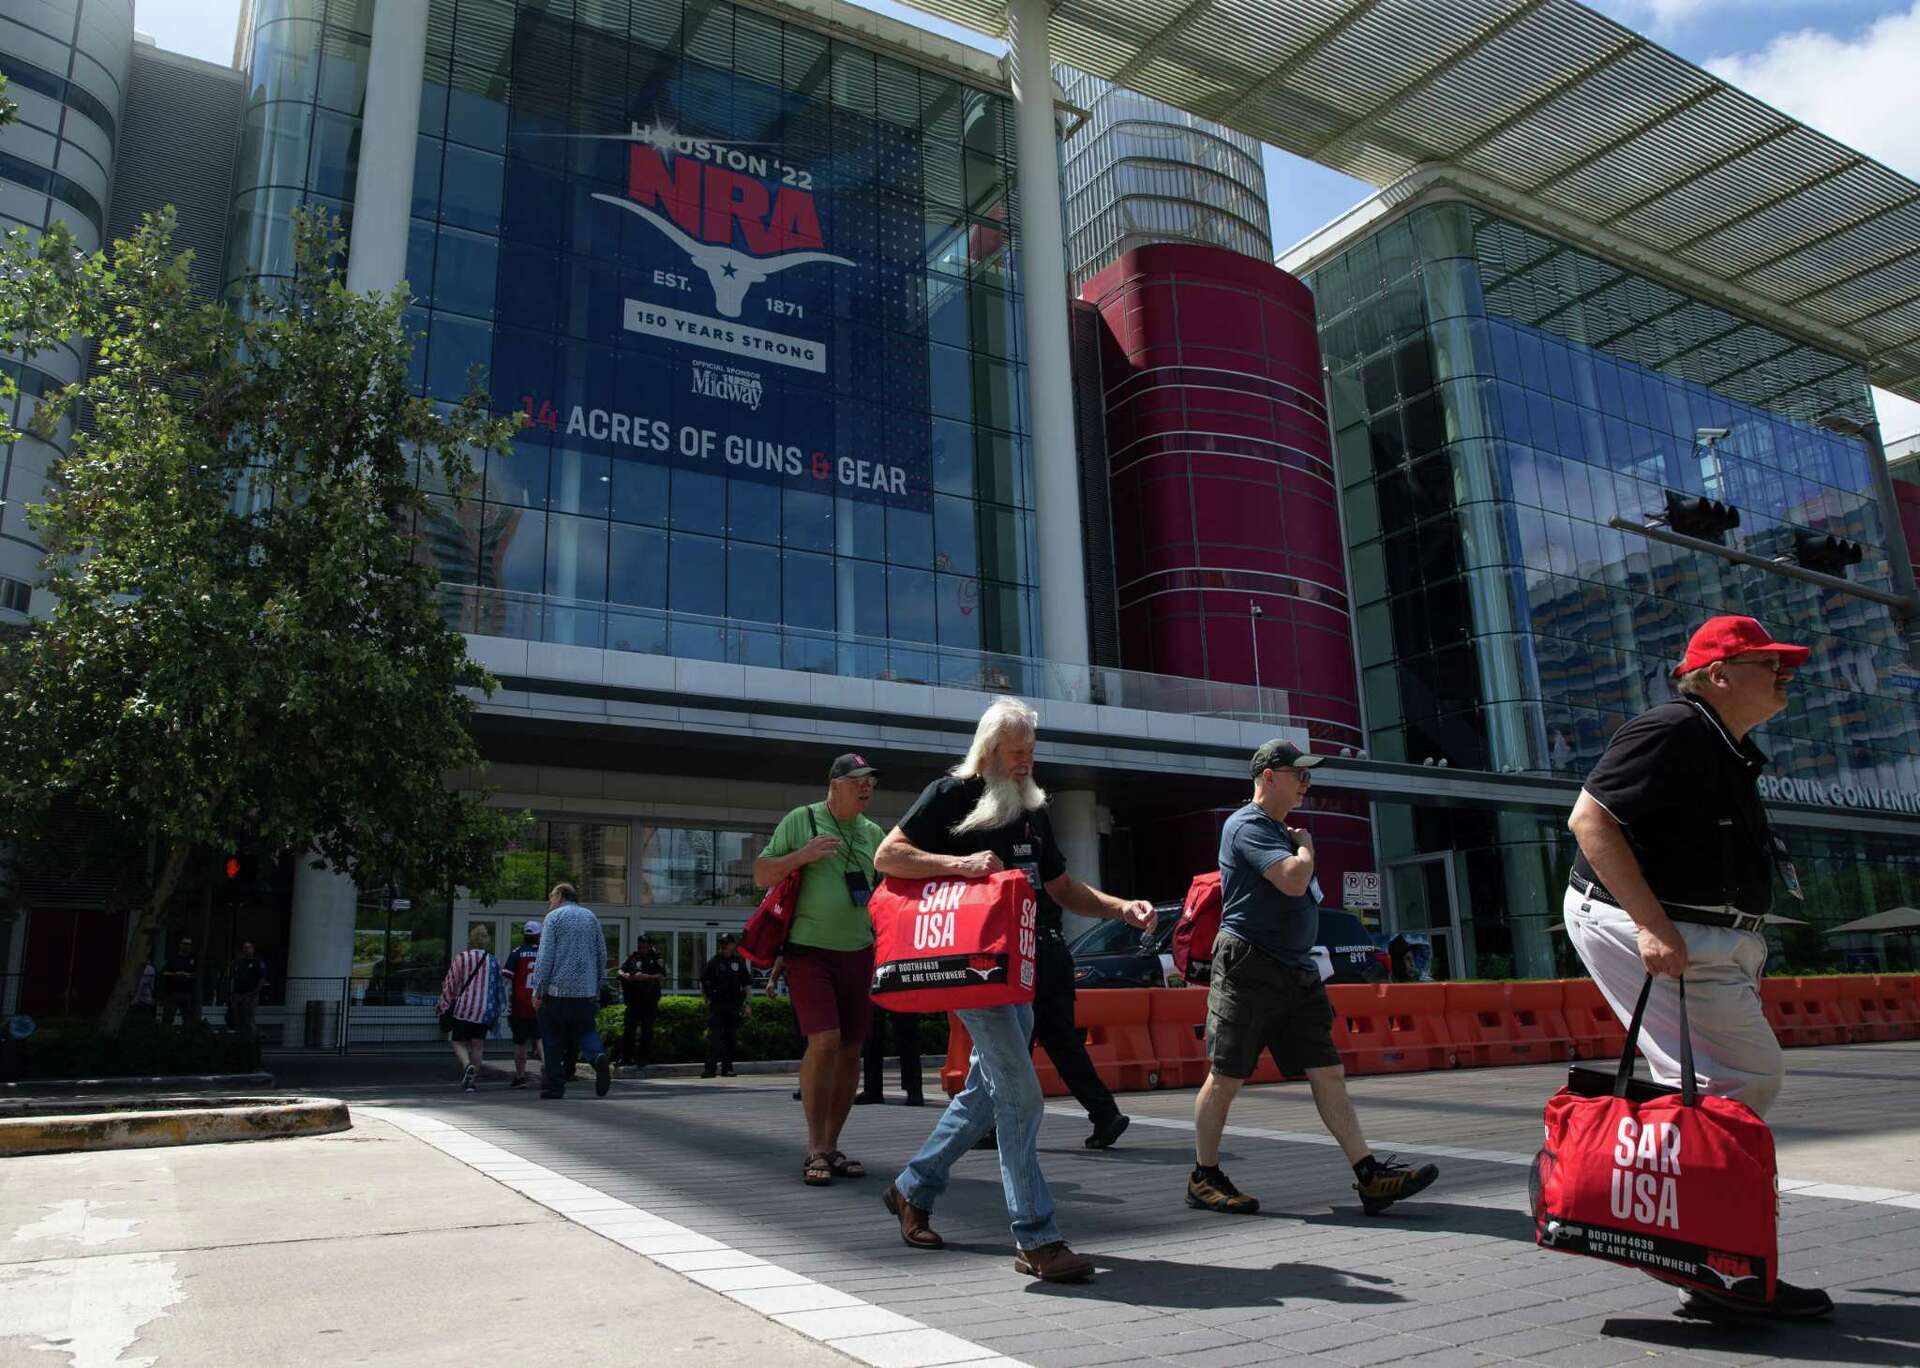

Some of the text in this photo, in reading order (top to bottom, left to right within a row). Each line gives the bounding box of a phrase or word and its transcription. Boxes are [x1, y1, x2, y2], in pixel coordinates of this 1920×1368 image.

[631, 121, 766, 177] HUSTON
[628, 143, 824, 255] NRA
[653, 270, 692, 292] EST.
[765, 298, 803, 319] 1871
[637, 311, 815, 361] 150 YEARS STRONG
[692, 359, 760, 379] OFFICIAL SPONSOR
[691, 367, 764, 411] Midway
[521, 396, 558, 433] 14
[566, 405, 670, 451] ACRES
[679, 426, 716, 458] OF
[725, 435, 803, 476] GUNS
[838, 456, 906, 495] GEAR
[1757, 774, 1825, 805] BROWN
[918, 880, 966, 913] SAR
[914, 911, 955, 950] USA
[1350, 952, 1366, 963] 911
[901, 969, 967, 983] WE ARE EVERYWHERE
[1614, 1116, 1682, 1176] SAR
[1610, 1168, 1679, 1230] USA
[1587, 1229, 1654, 1251] BOOTH#4639
[1589, 1241, 1698, 1275] WE ARE EVERYWHERE
